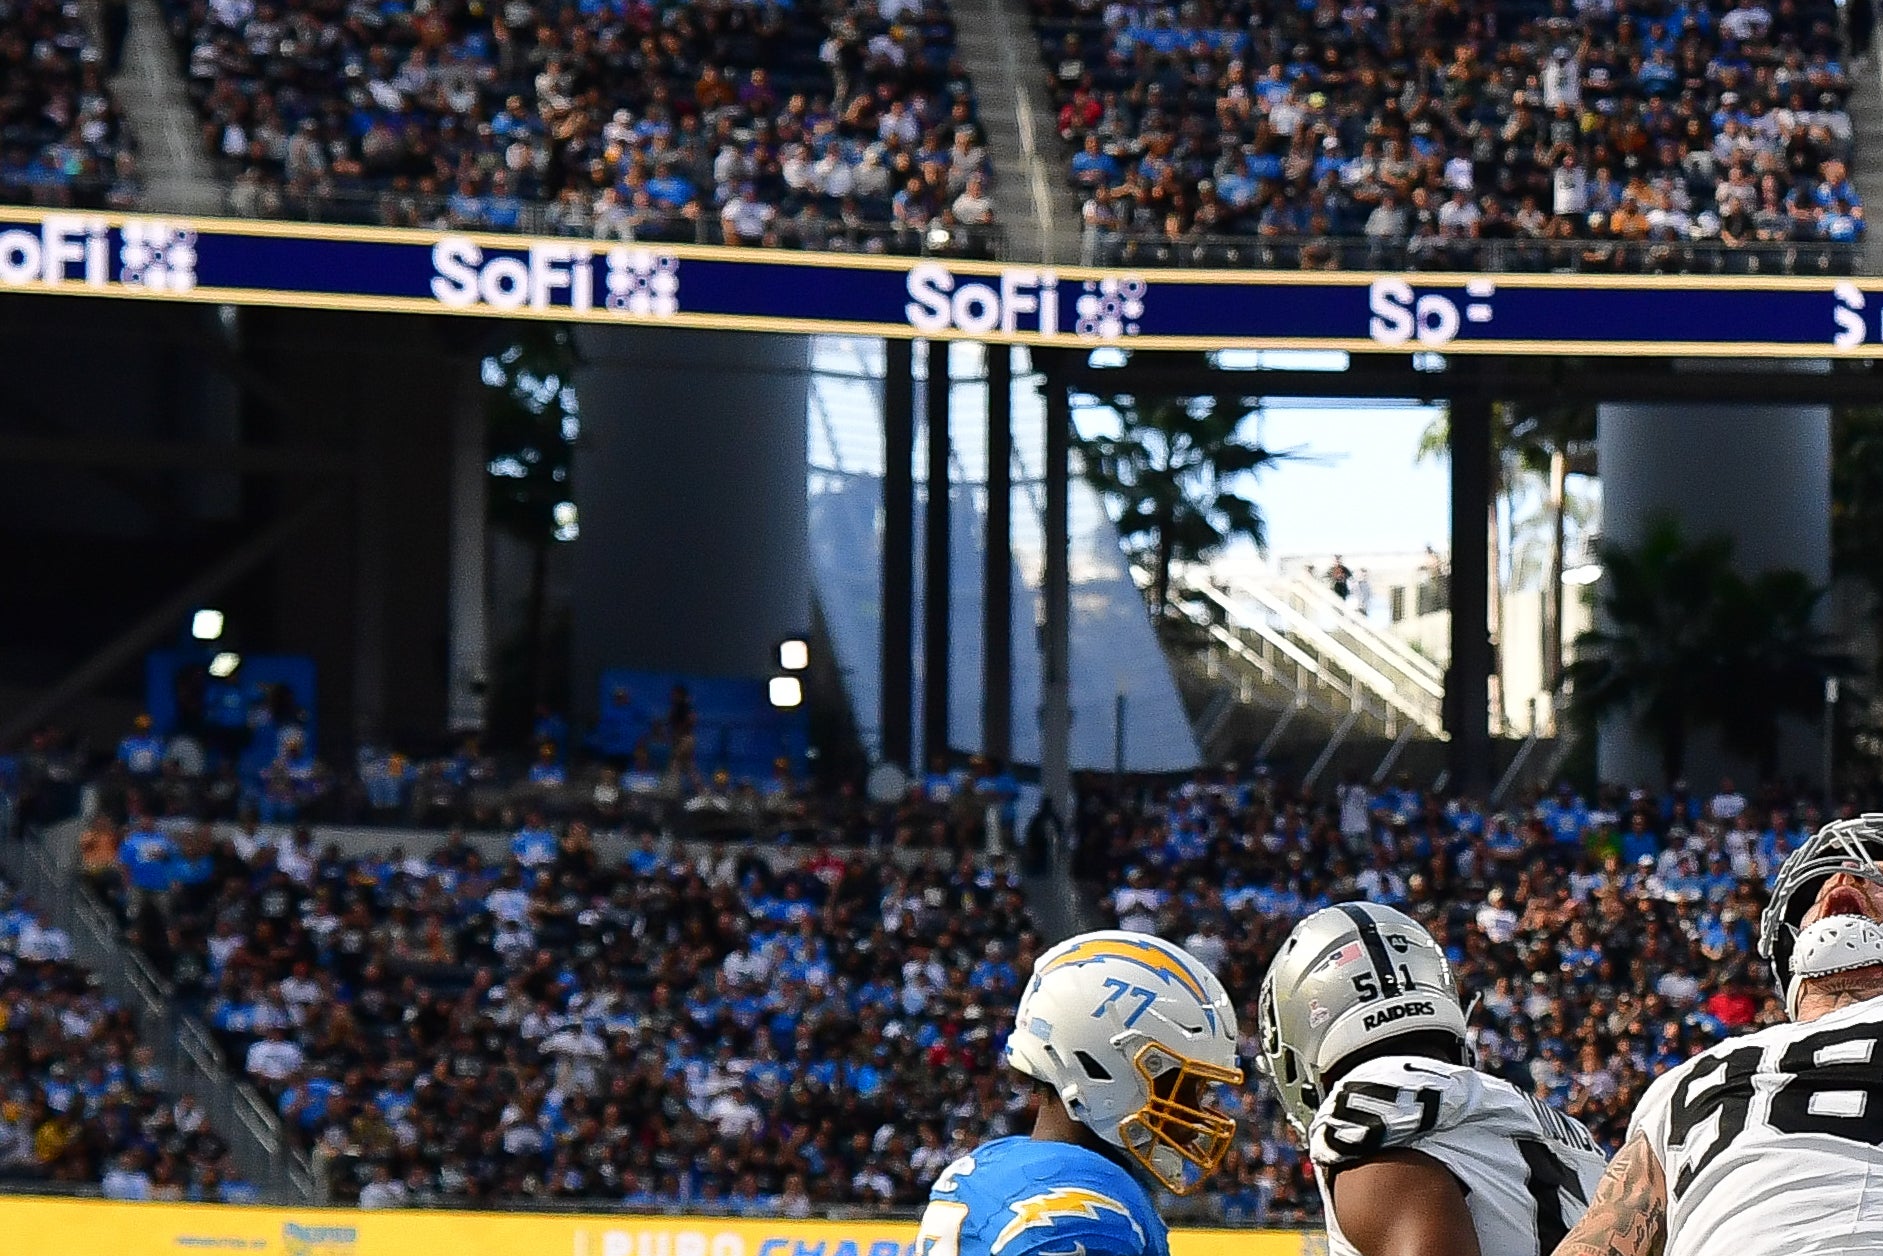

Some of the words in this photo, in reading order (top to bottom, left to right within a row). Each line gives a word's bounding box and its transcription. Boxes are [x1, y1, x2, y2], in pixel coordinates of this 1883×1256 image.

[431, 236, 593, 310] SoFi
[905, 261, 1059, 335] SoFi
[1092, 977, 1158, 1028] 77
[1351, 964, 1417, 1003] 51
[1362, 1001, 1436, 1032] RAIDERS
